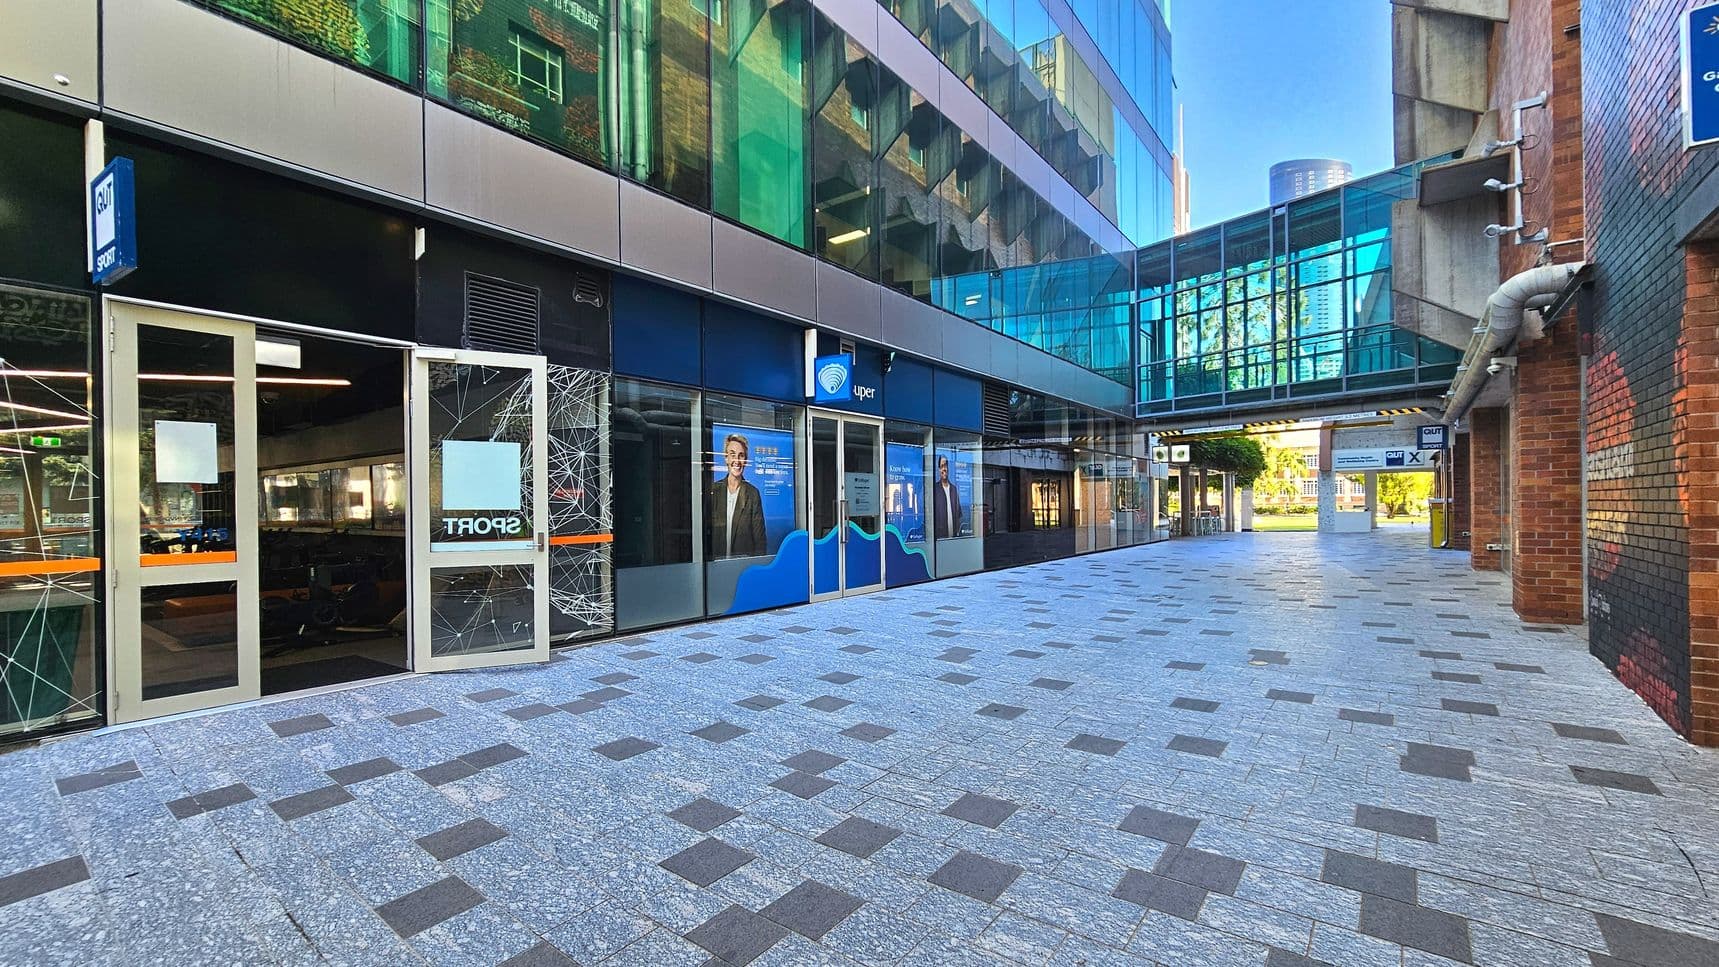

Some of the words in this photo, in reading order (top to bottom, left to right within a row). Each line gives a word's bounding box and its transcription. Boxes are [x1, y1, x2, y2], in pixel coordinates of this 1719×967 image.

[96, 181, 113, 215] QUT
[96, 246, 117, 273] SPORT
[853, 384, 875, 401] uper
[1408, 451, 1420, 463] X
[889, 465, 901, 473] Know
